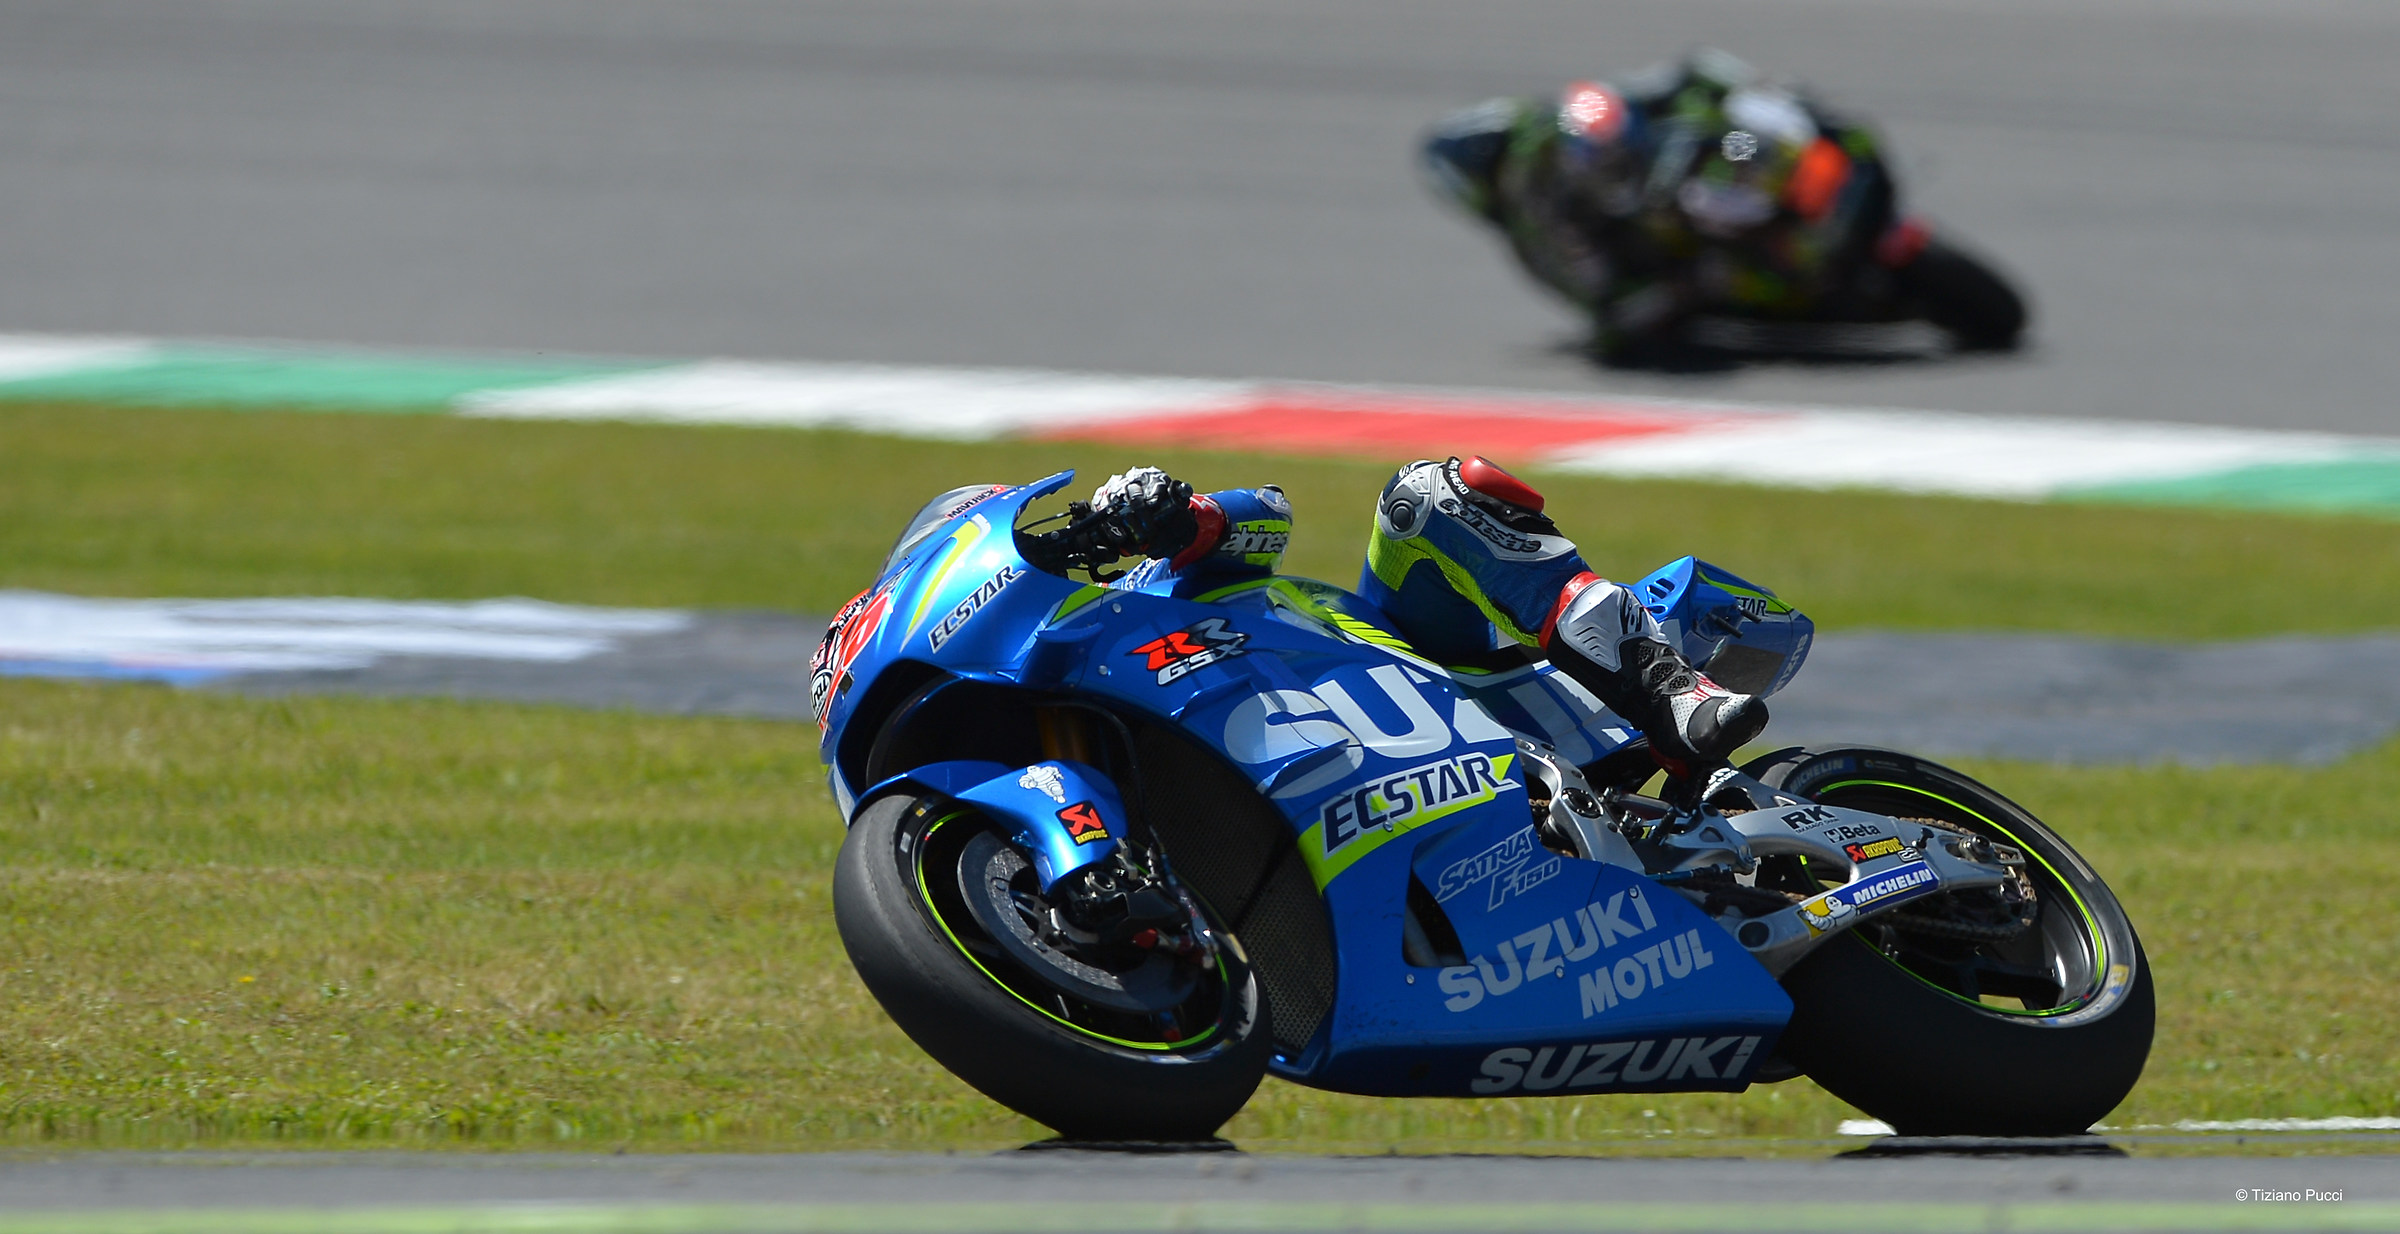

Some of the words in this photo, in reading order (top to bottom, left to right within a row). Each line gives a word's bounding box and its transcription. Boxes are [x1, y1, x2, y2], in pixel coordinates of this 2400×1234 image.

[927, 565, 1026, 653] ECSTAR
[1158, 638, 1245, 685] GSX
[1321, 753, 1520, 859] ECSTAR
[1781, 806, 1835, 830] RK
[1839, 823, 1881, 839] Beta
[1437, 825, 1535, 902] SATRIA
[1852, 868, 1934, 905] MICHELIN
[1437, 884, 1658, 1013] SUZUKI
[1578, 929, 1714, 1019] MOTUL
[1471, 1035, 1762, 1094] SUZUKI
